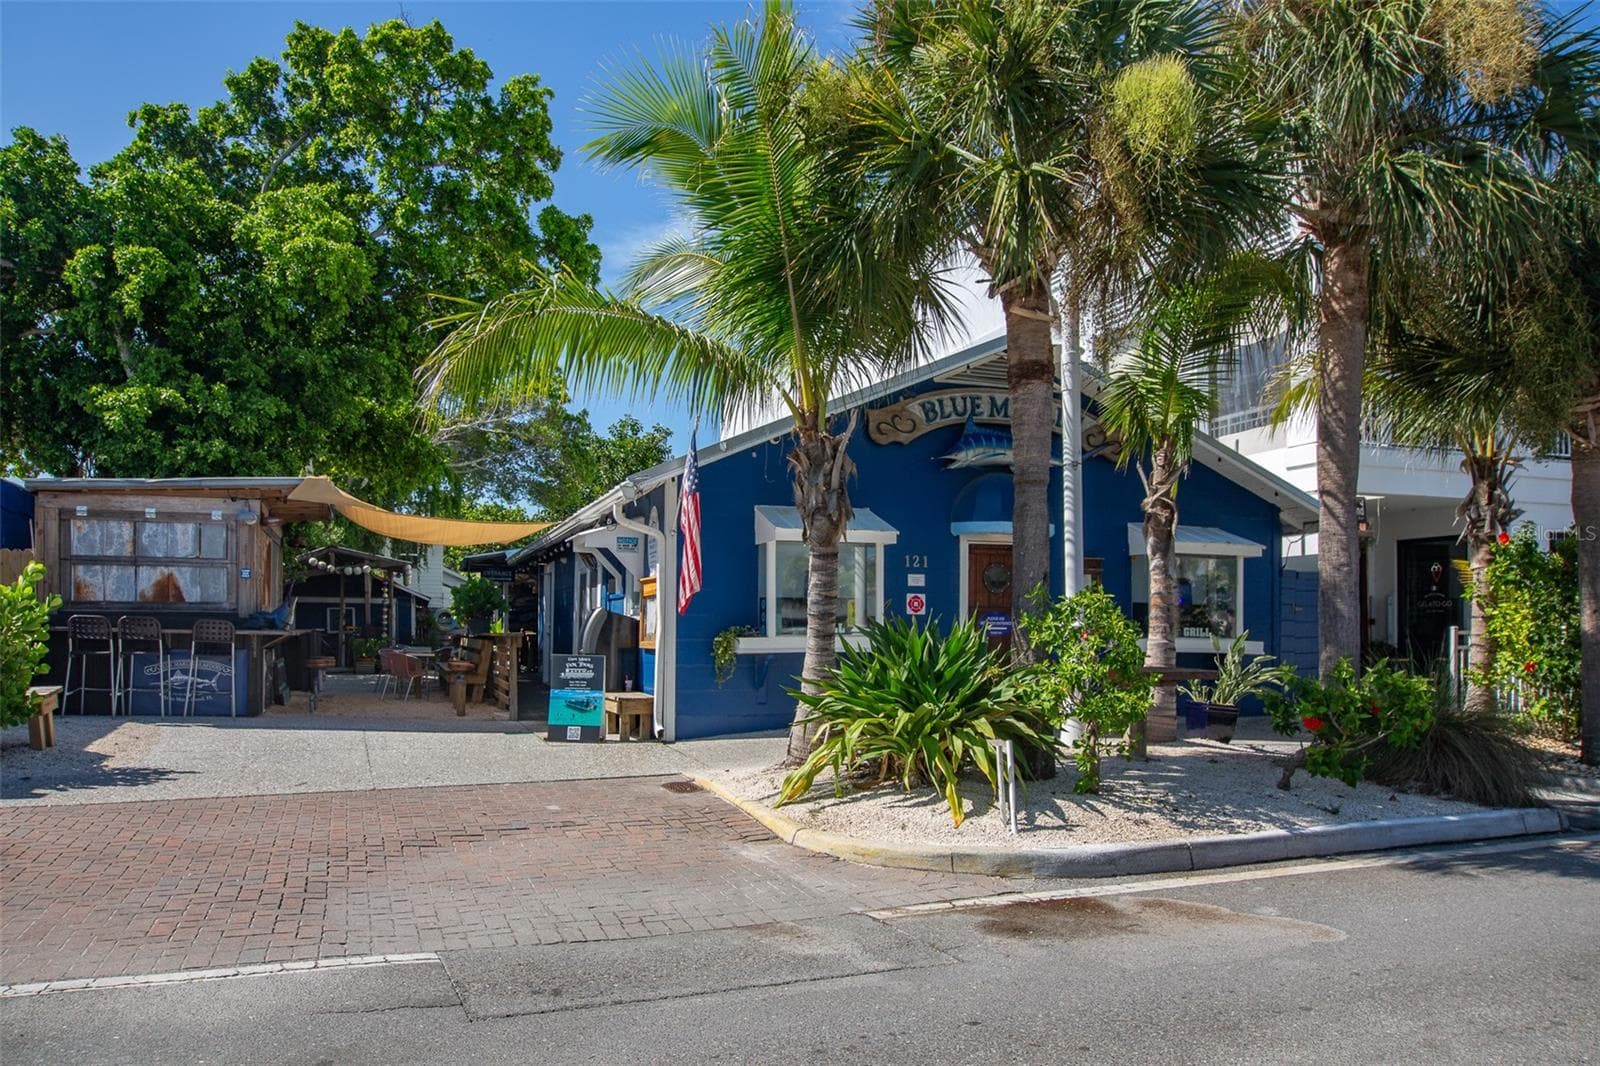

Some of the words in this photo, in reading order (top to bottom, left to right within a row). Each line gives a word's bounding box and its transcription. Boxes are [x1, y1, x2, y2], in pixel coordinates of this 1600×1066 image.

[919, 395, 984, 424] BLUE
[905, 554, 928, 568] 121
[1183, 627, 1210, 637] GRILL
